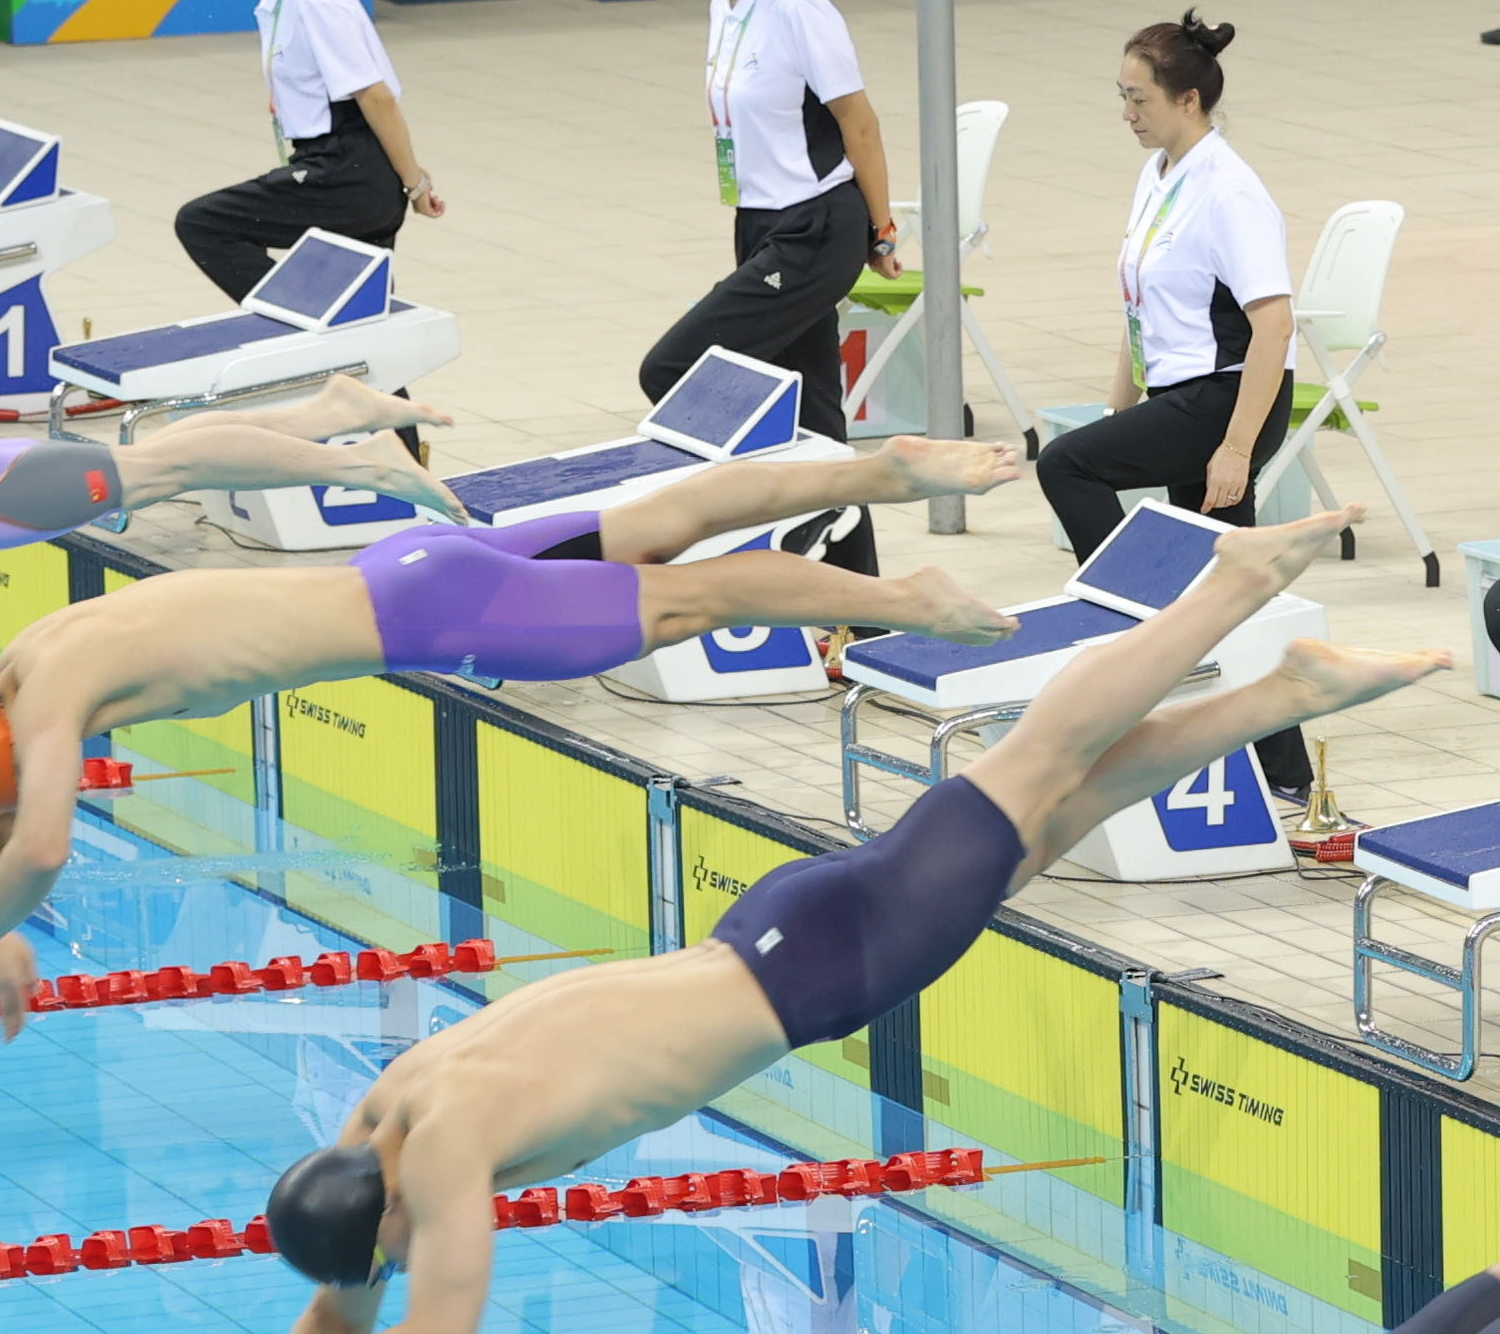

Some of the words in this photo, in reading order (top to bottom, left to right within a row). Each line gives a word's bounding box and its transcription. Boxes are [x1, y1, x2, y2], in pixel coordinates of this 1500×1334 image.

[299, 697, 331, 725] SWISS
[1166, 754, 1236, 826] 4
[710, 871, 748, 897] SWISS
[1190, 1073, 1236, 1106] SWISS
[1238, 1091, 1286, 1127] TIMING
